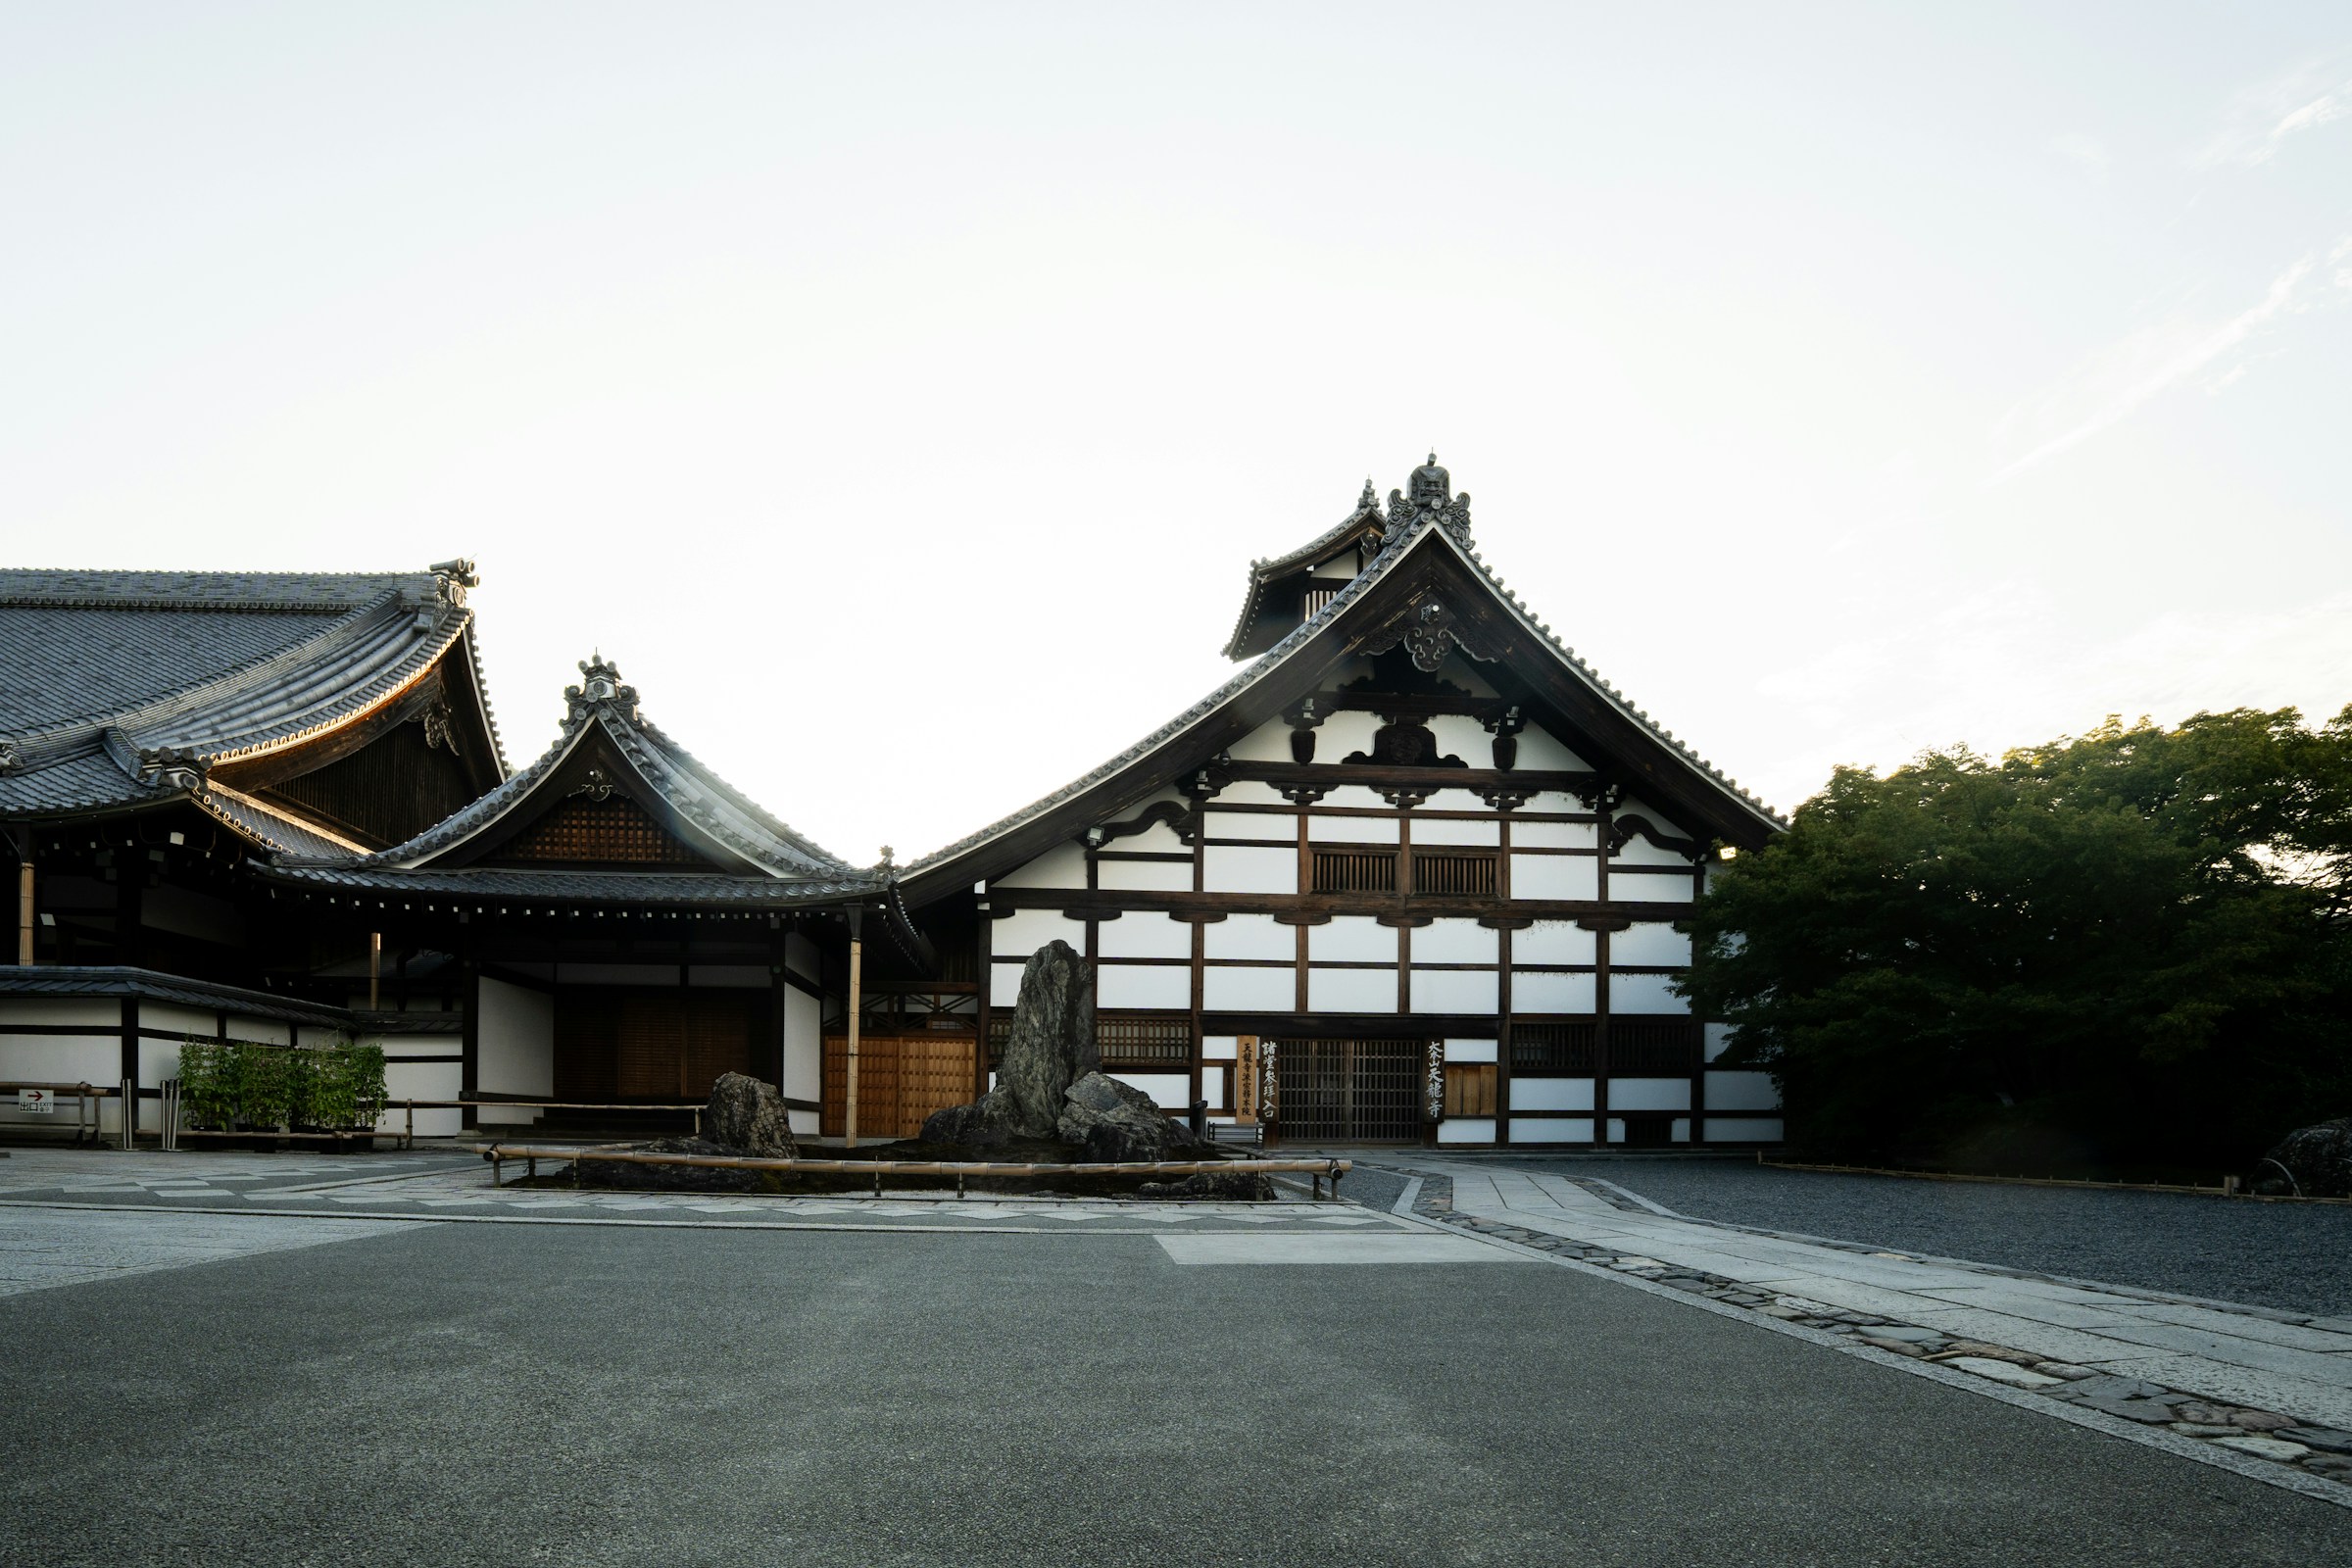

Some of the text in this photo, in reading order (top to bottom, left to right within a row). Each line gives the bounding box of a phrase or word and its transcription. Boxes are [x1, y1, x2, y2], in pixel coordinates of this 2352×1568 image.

[1426, 1041, 1445, 1118] 大本山天龍寺
[20, 1102, 38, 1111] 出口
